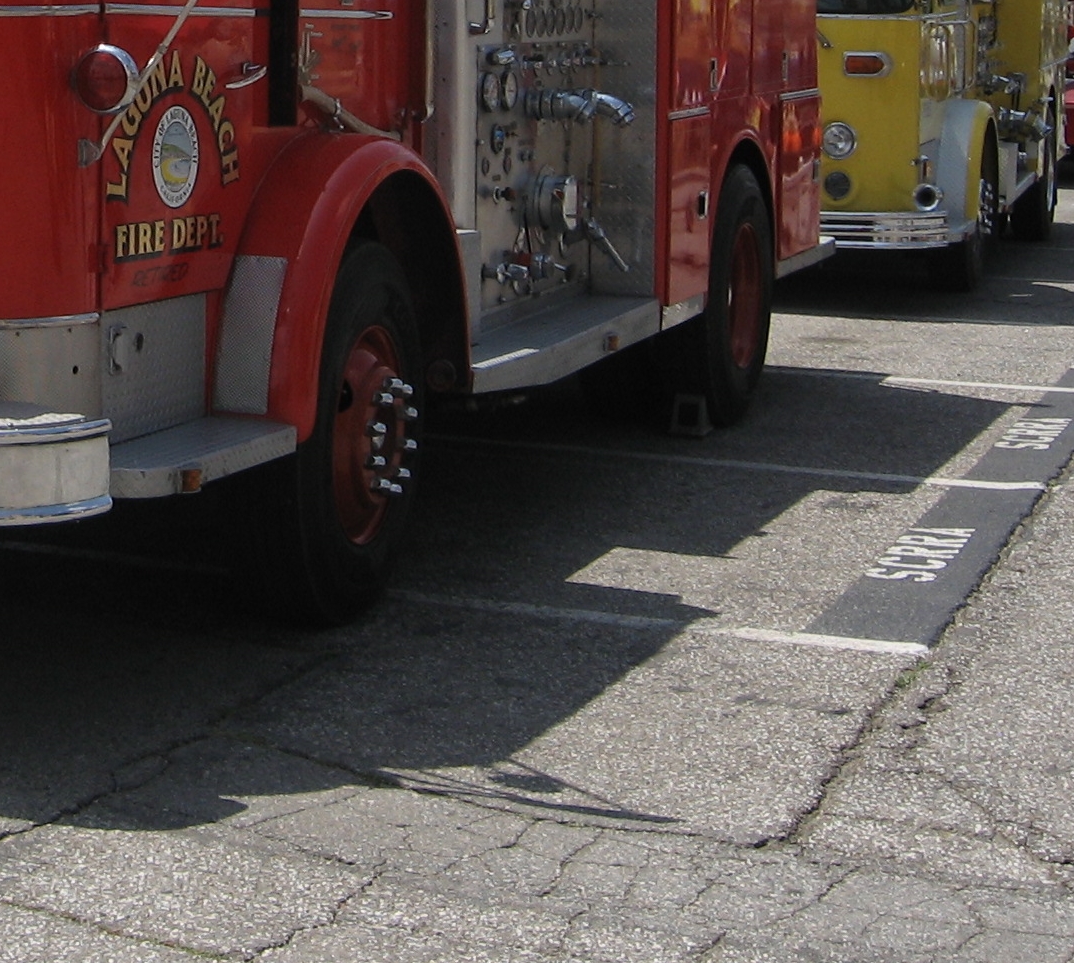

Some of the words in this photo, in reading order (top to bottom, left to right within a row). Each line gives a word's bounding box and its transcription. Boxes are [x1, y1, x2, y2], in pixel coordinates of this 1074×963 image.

[107, 50, 183, 201] LAGUNA
[192, 56, 239, 185] BEACH
[116, 220, 165, 259] FIRE
[171, 213, 223, 250] DEPT.
[994, 417, 1073, 450] SCRRA
[864, 527, 976, 583] SCRRA
